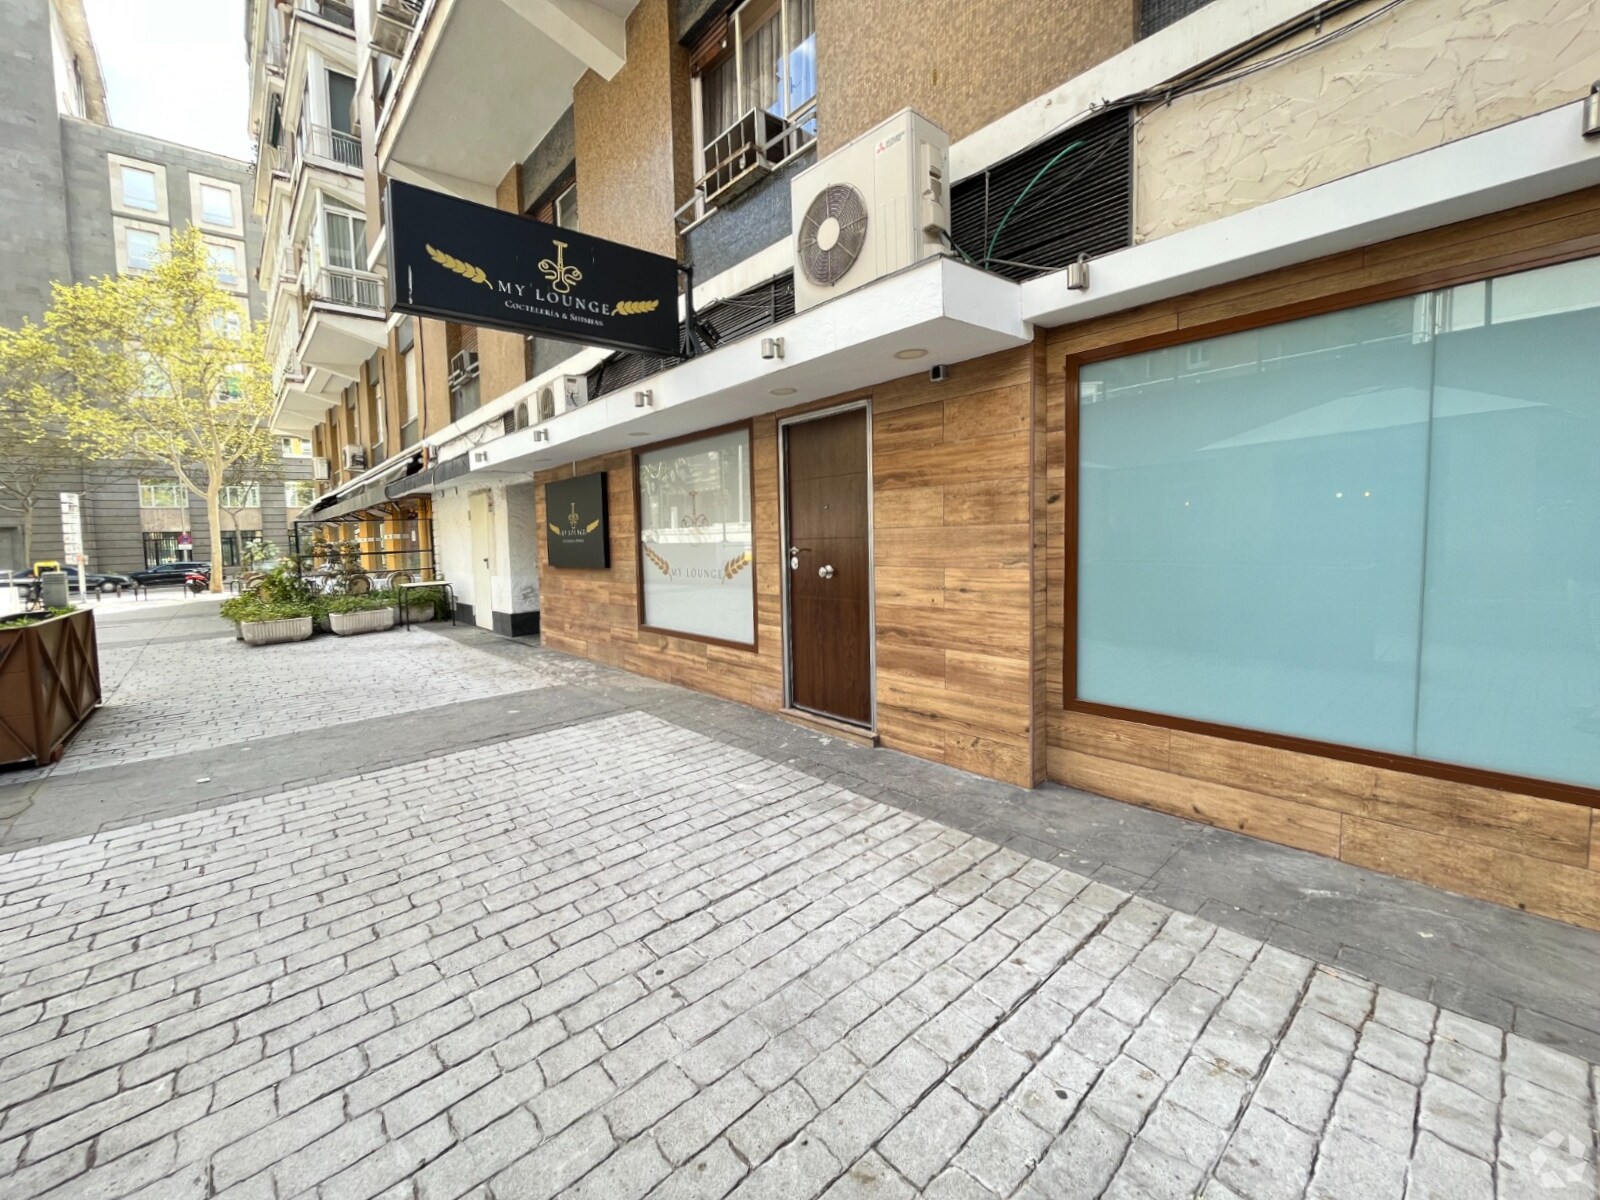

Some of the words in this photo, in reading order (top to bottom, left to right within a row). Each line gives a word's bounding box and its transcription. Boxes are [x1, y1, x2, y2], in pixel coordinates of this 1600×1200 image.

[498, 280, 525, 297] MY
[535, 288, 610, 316] LOUNGE
[671, 567, 682, 577] MY
[686, 567, 722, 579] LOUNGE
